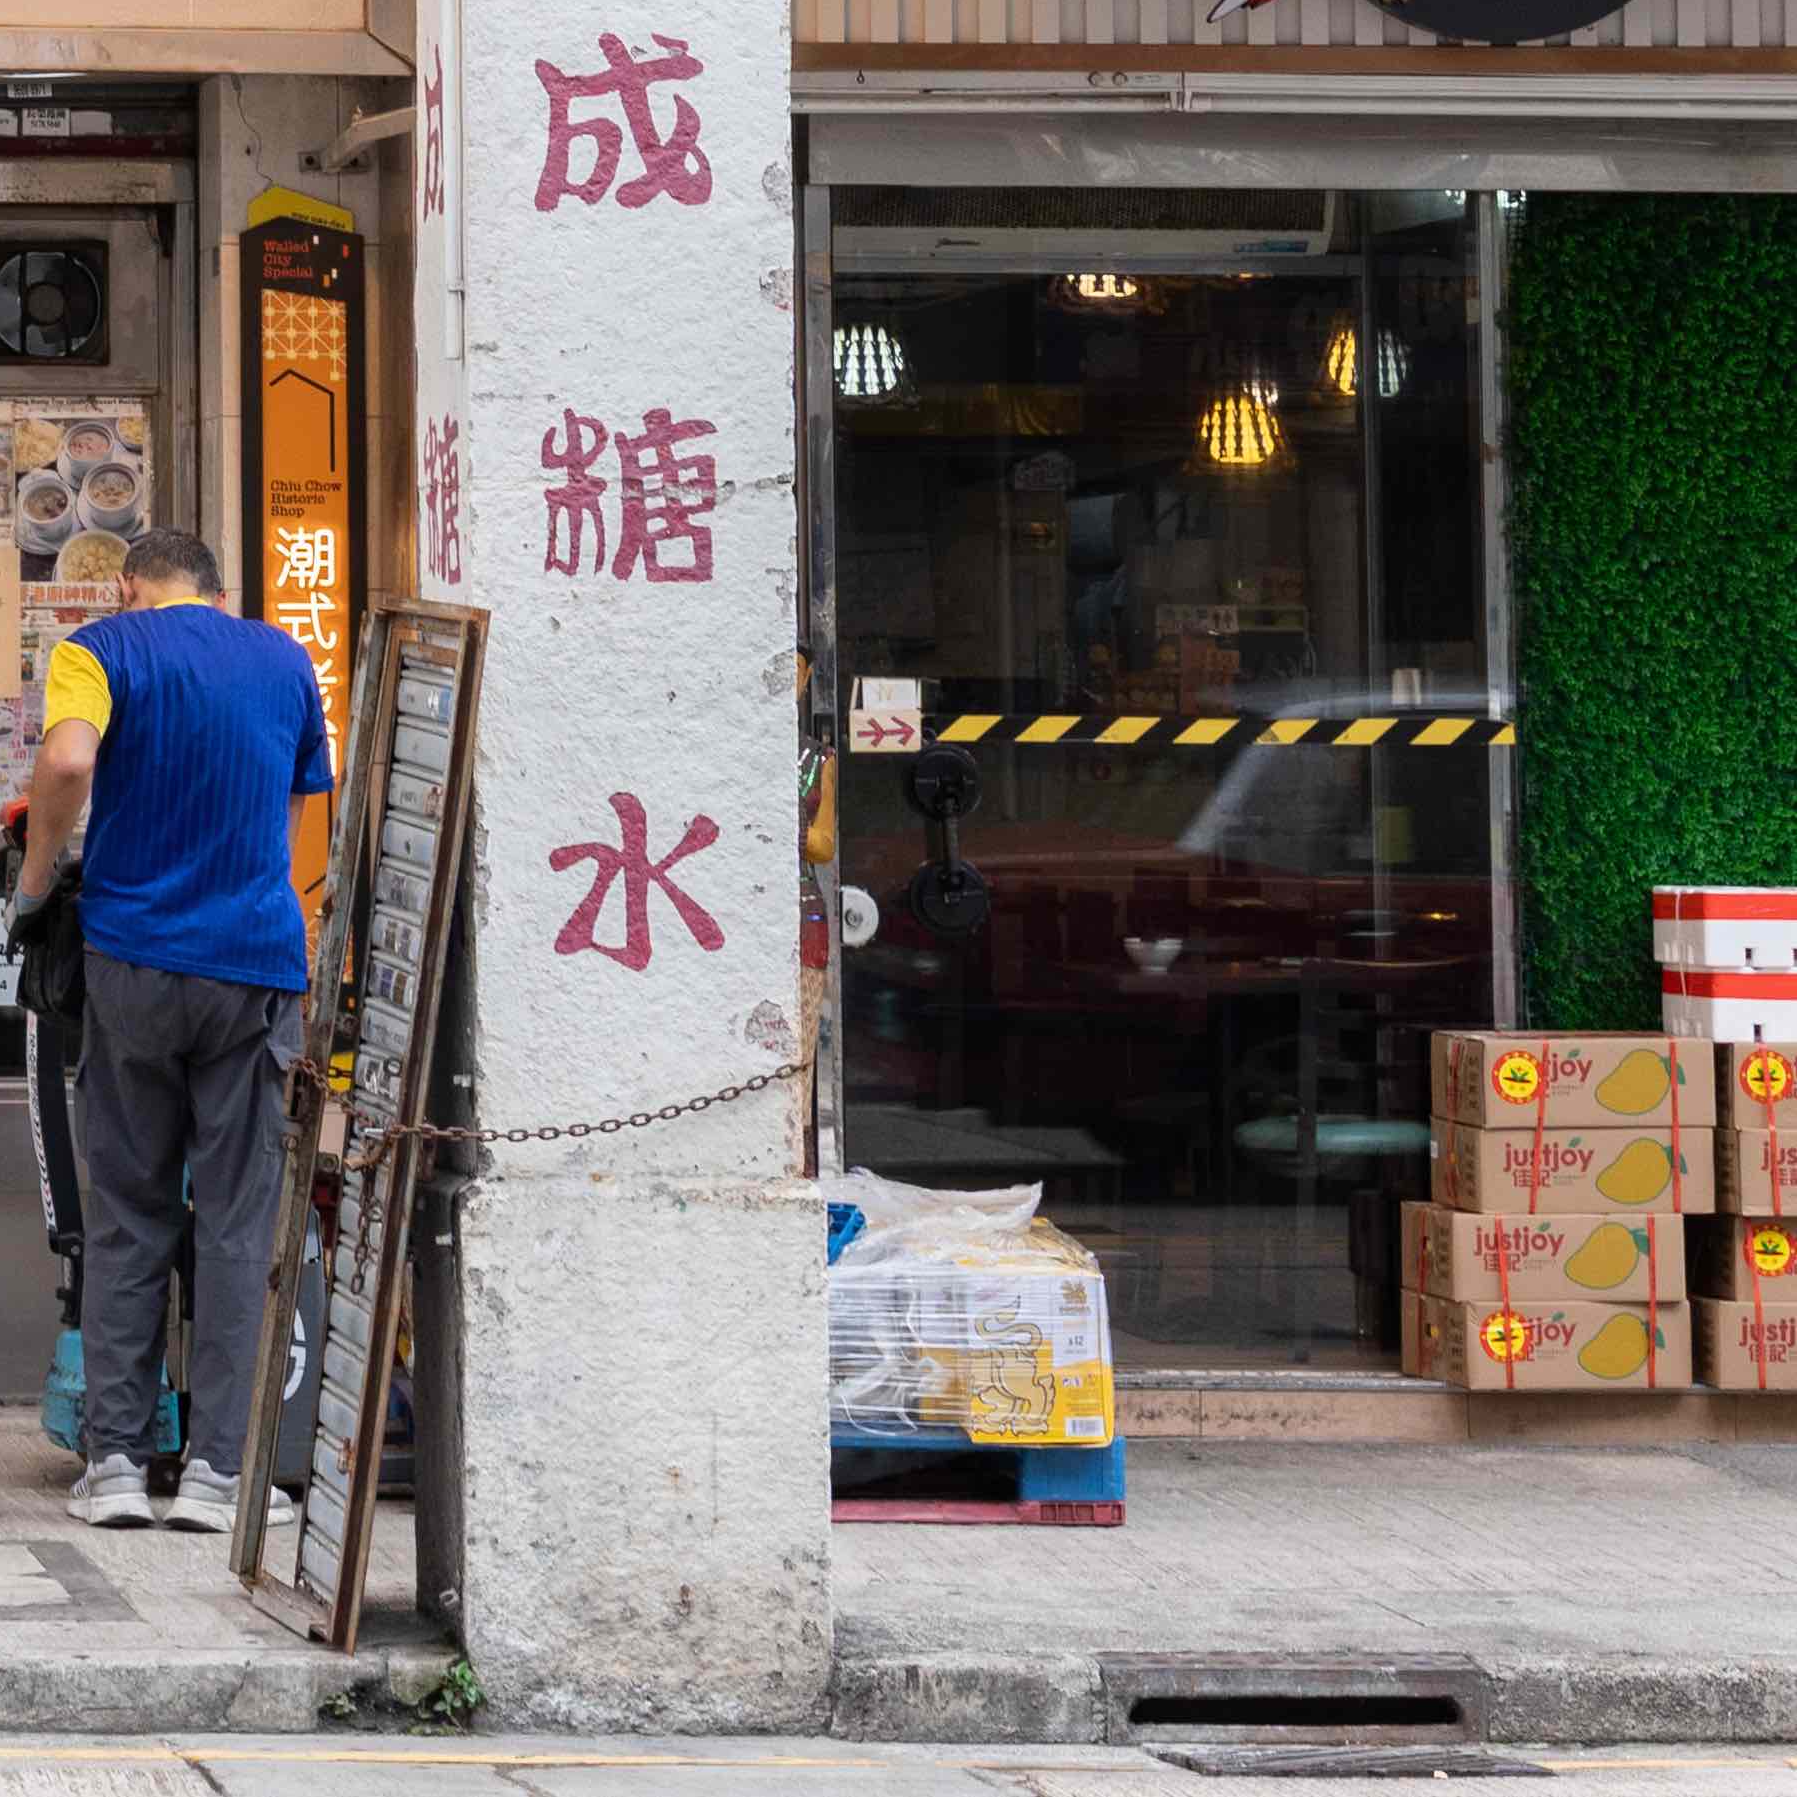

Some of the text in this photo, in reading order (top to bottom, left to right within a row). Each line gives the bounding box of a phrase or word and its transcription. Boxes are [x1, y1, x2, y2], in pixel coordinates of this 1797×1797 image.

[263, 240, 310, 253] Walled
[263, 254, 292, 267] City
[270, 479, 343, 492] Chiu Chow
[270, 492, 326, 505] Historic
[270, 505, 305, 518] Shop
[1503, 1138, 1595, 1173] justjoy
[1473, 1226, 1566, 1257] justjoy
